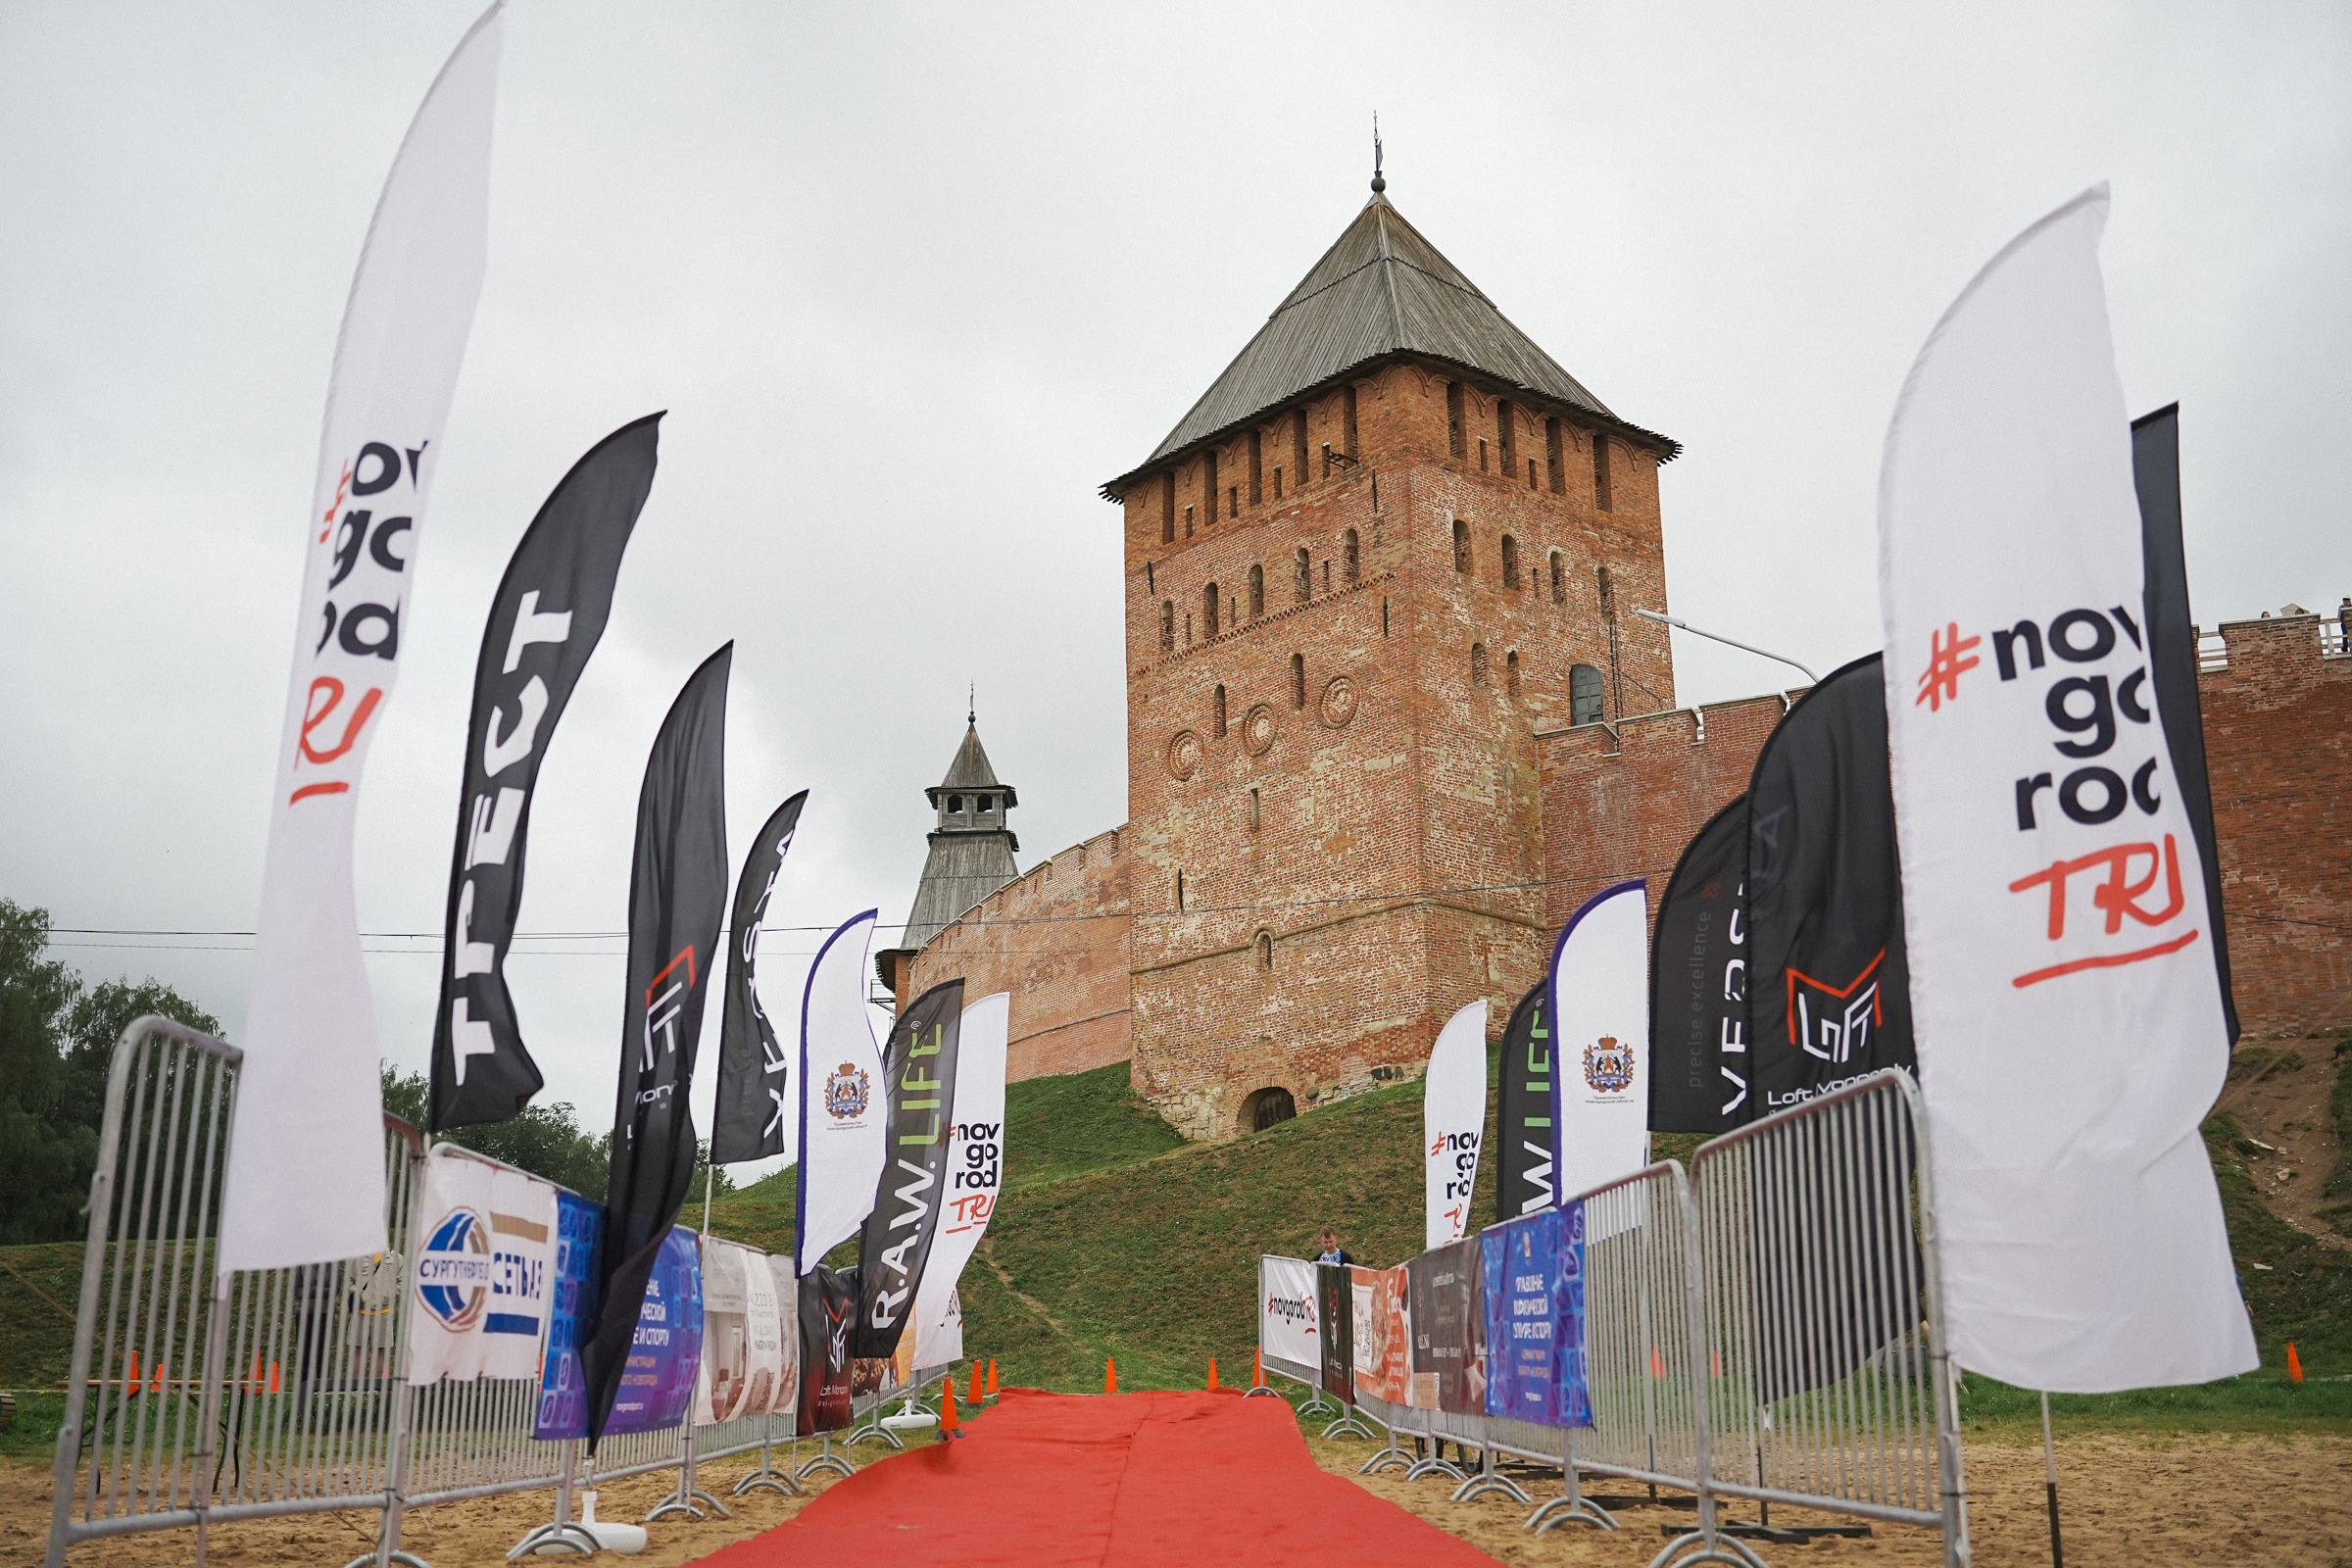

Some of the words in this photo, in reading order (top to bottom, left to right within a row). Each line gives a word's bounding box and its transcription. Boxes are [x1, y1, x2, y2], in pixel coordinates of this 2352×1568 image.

[1767, 1087, 1813, 1105] Loft
[965, 1143, 999, 1169] go
[955, 1159, 998, 1189] rod
